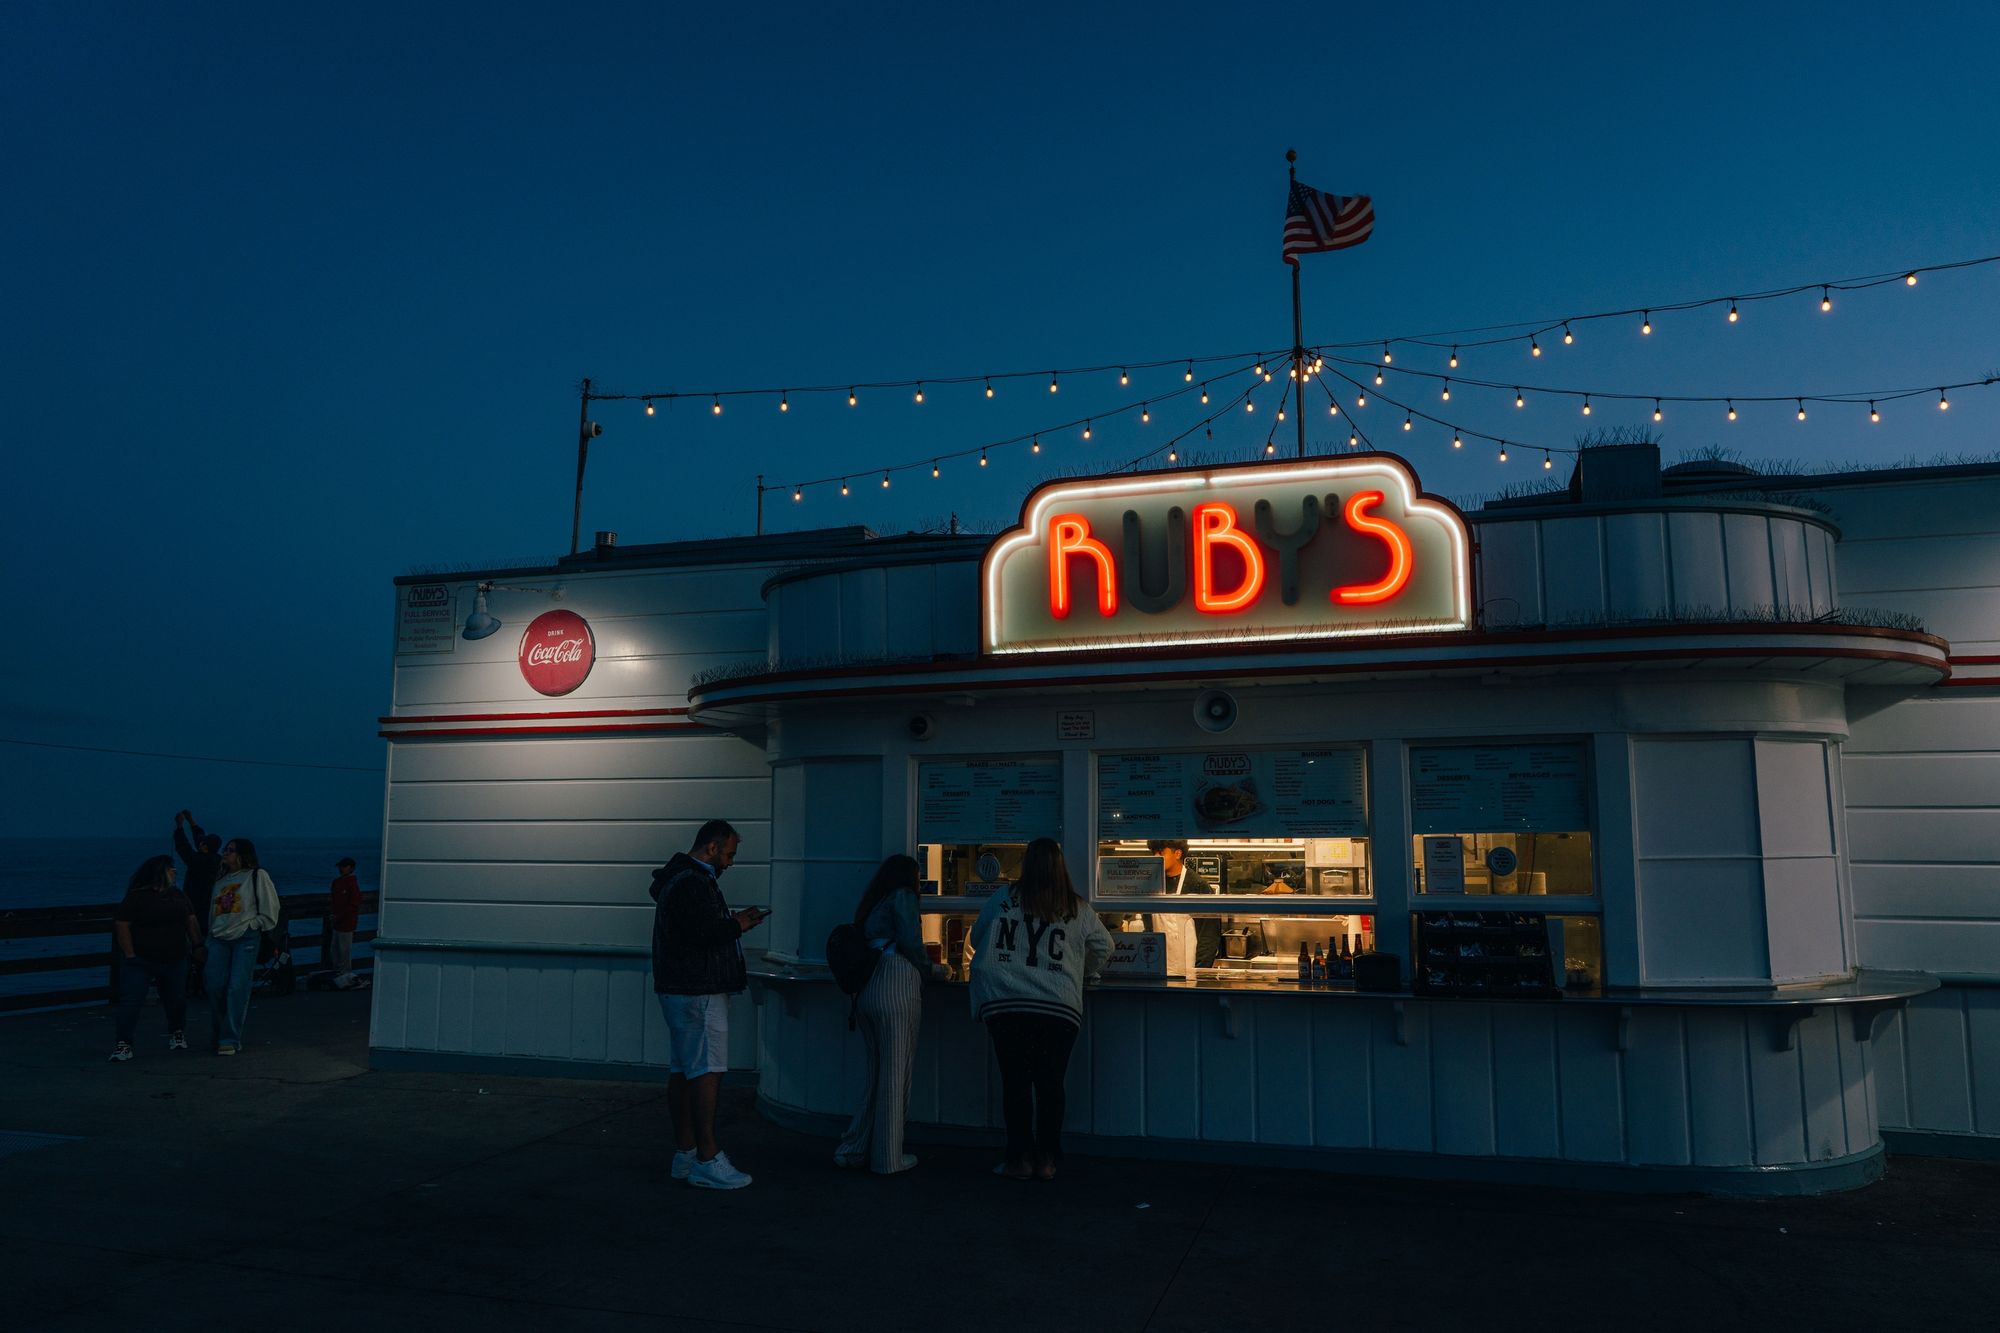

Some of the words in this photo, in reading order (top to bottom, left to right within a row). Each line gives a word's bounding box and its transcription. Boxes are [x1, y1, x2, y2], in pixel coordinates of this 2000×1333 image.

[1048, 491, 1413, 619] RUBY'S
[547, 629, 564, 637] DRINK
[528, 638, 585, 666] Coca-Cola
[999, 896, 1024, 912] NE
[996, 913, 1066, 967] NYC
[998, 953, 1012, 962] EST.
[1108, 954, 1137, 968] pen!
